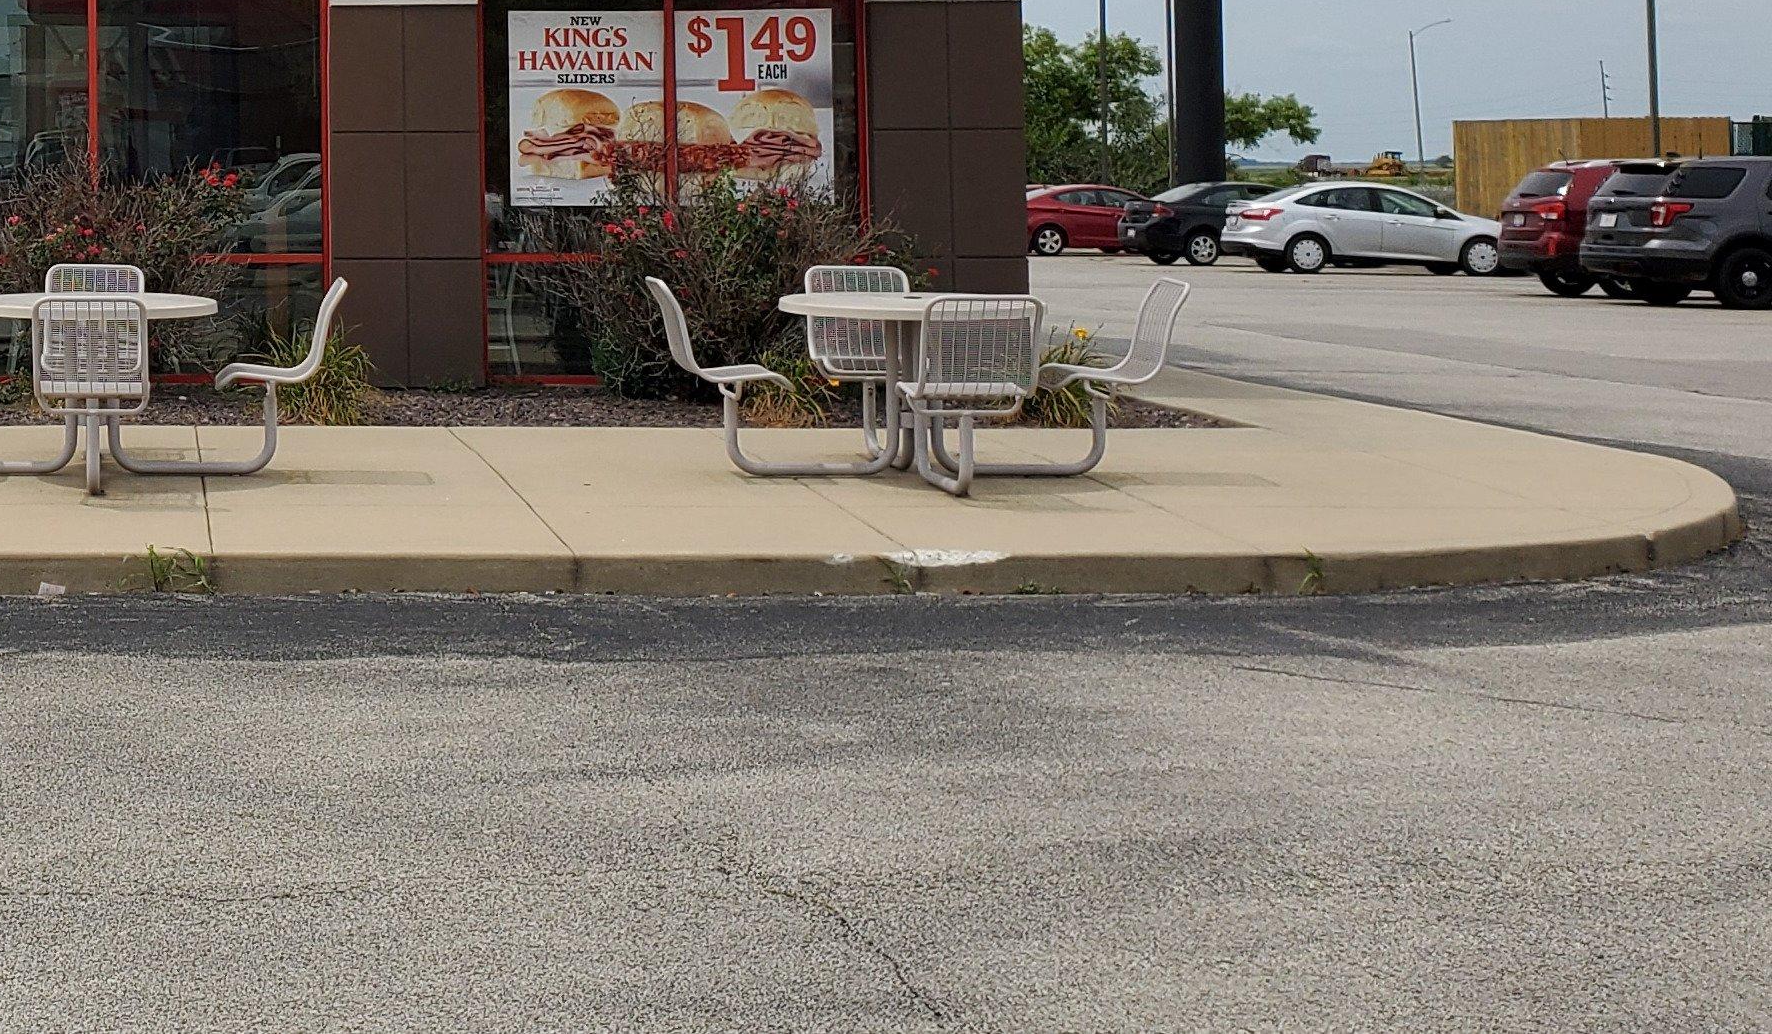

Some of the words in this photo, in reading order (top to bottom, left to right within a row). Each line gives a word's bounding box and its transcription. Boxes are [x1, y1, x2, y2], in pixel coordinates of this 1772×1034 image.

[570, 16, 602, 26] NEW
[543, 26, 628, 48] KING'S
[517, 51, 654, 71] HAWAIIAN
[557, 73, 616, 84] SLIDERS
[758, 63, 788, 80] EACH
